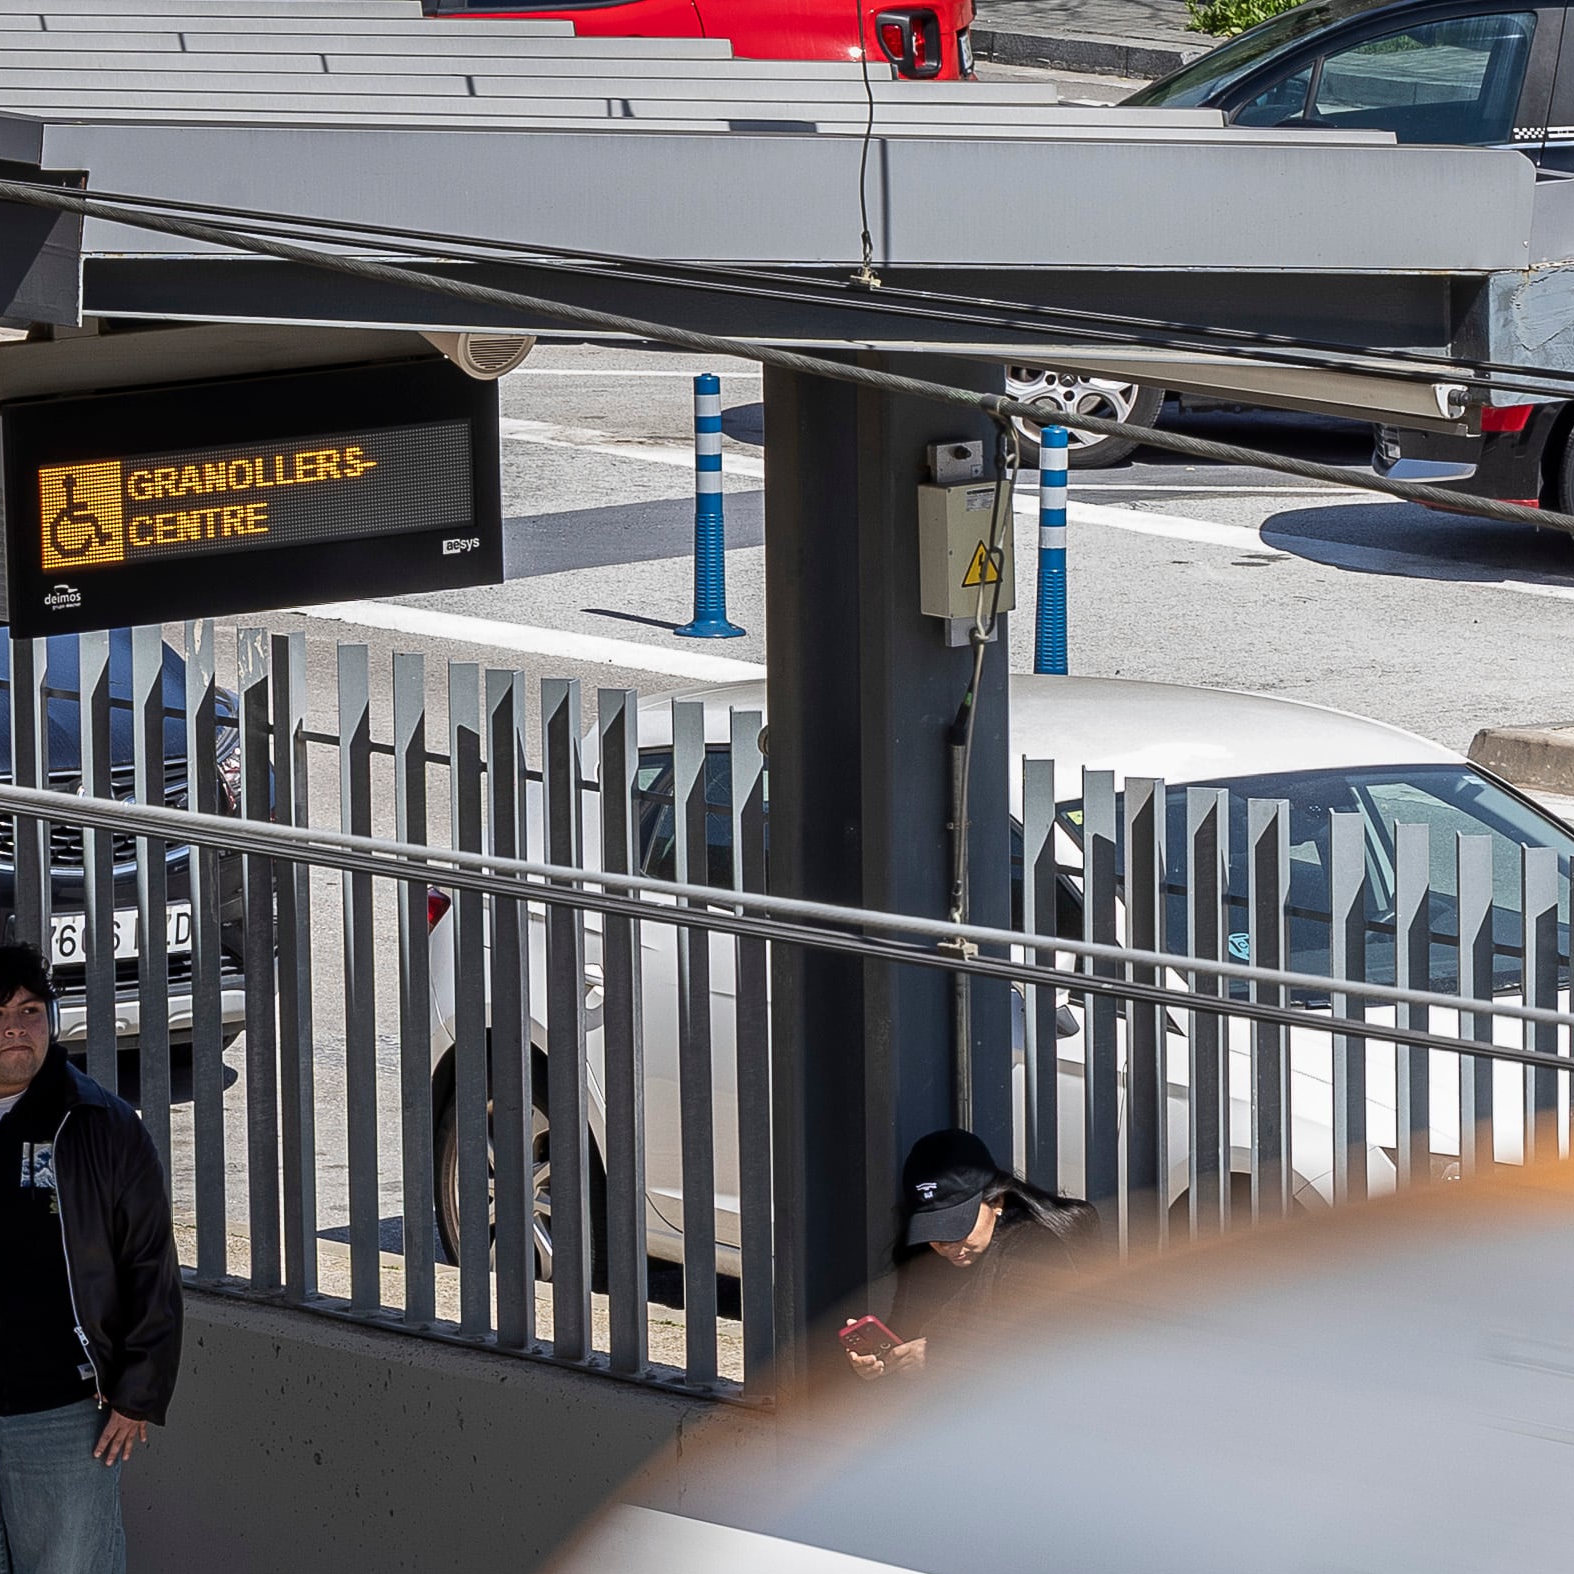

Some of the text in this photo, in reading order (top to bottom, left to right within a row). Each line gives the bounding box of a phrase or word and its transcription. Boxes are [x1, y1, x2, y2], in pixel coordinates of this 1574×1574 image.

[128, 502, 269, 546] CENTRE
[443, 537, 480, 554] aesys
[44, 592, 81, 605] deimos
